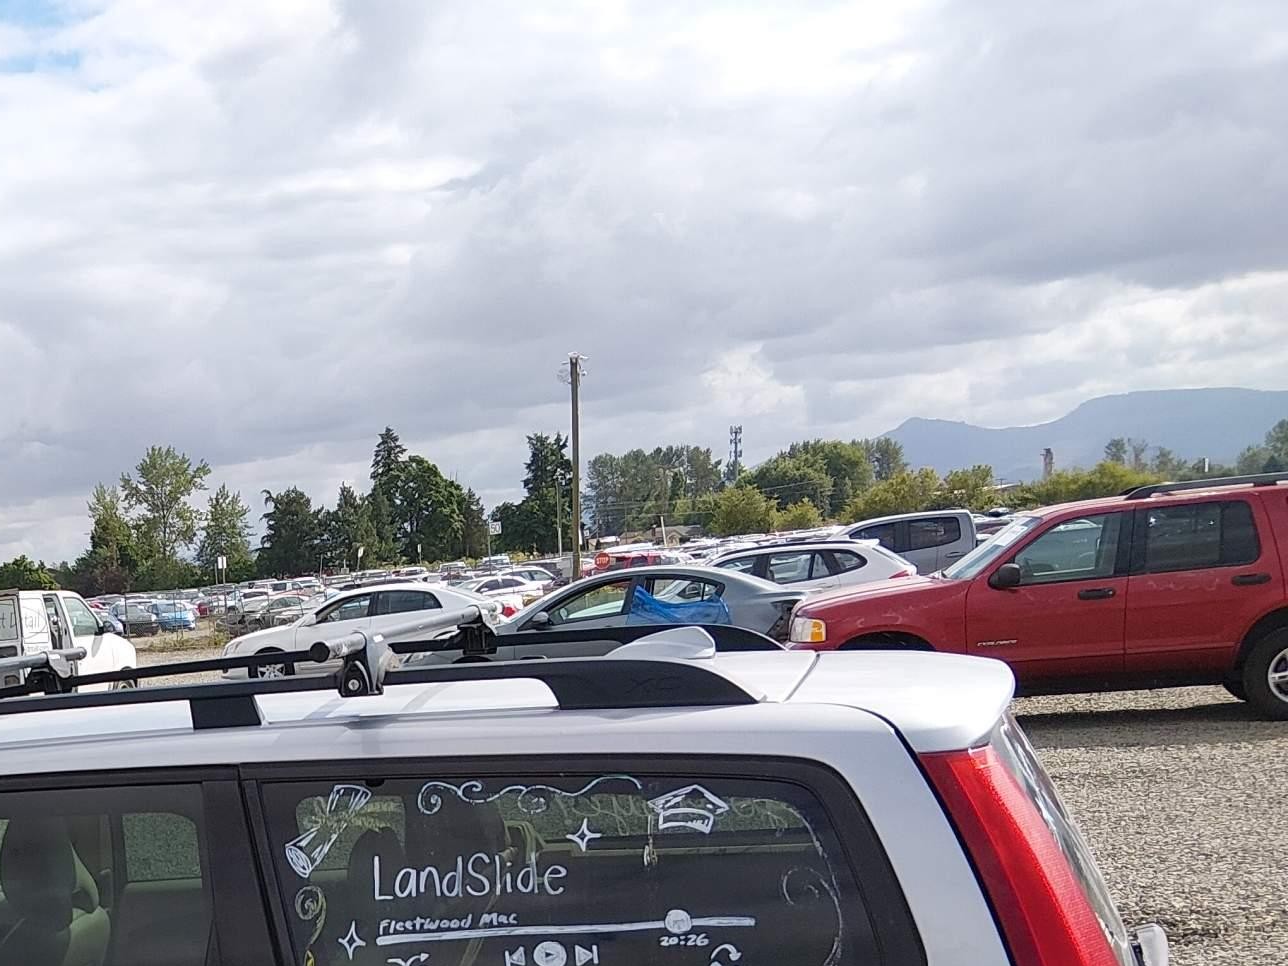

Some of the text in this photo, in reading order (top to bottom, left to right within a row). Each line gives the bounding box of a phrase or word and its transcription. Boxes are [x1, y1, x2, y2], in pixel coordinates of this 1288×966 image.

[596, 556, 609, 565] STOP
[379, 912, 518, 935] Fleetwood Mac
[659, 934, 709, 947] 20:26
